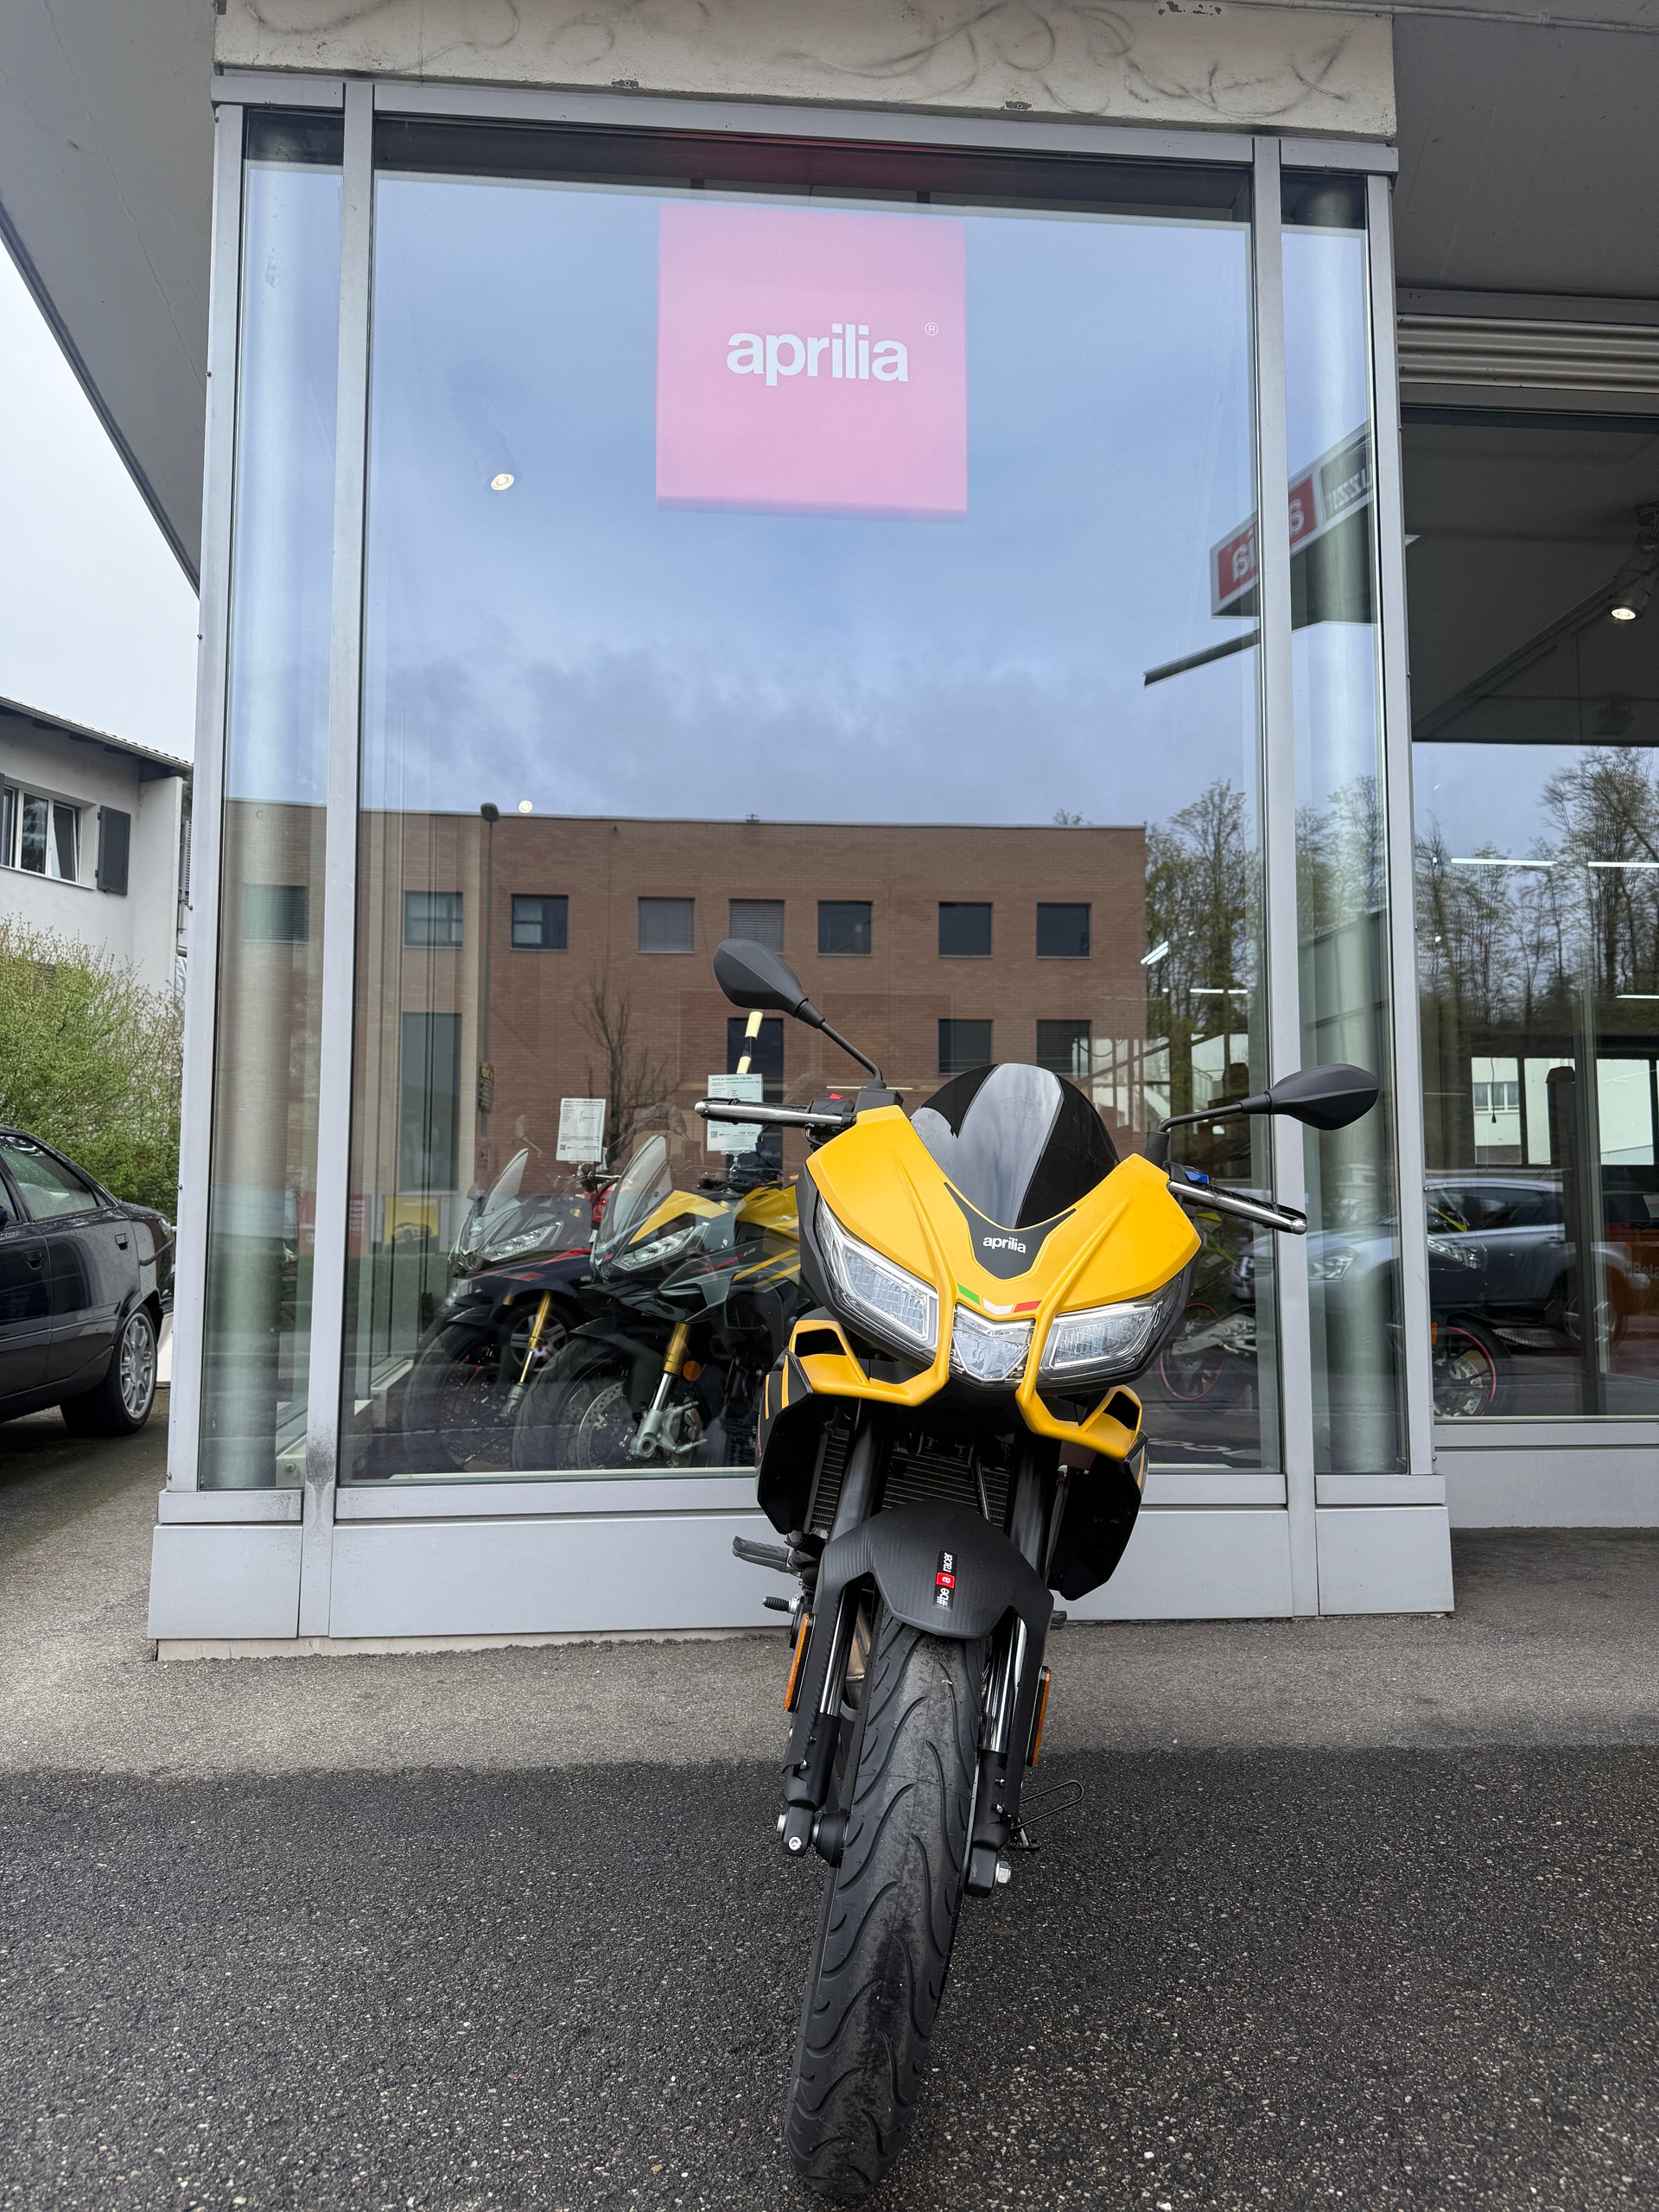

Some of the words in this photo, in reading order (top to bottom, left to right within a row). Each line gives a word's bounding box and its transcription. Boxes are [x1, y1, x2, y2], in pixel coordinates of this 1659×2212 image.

[726, 322, 909, 386] aprilia
[982, 1236, 1027, 1254] aprilia
[943, 1552, 953, 1573] racer
[937, 1587, 950, 1606] #be
